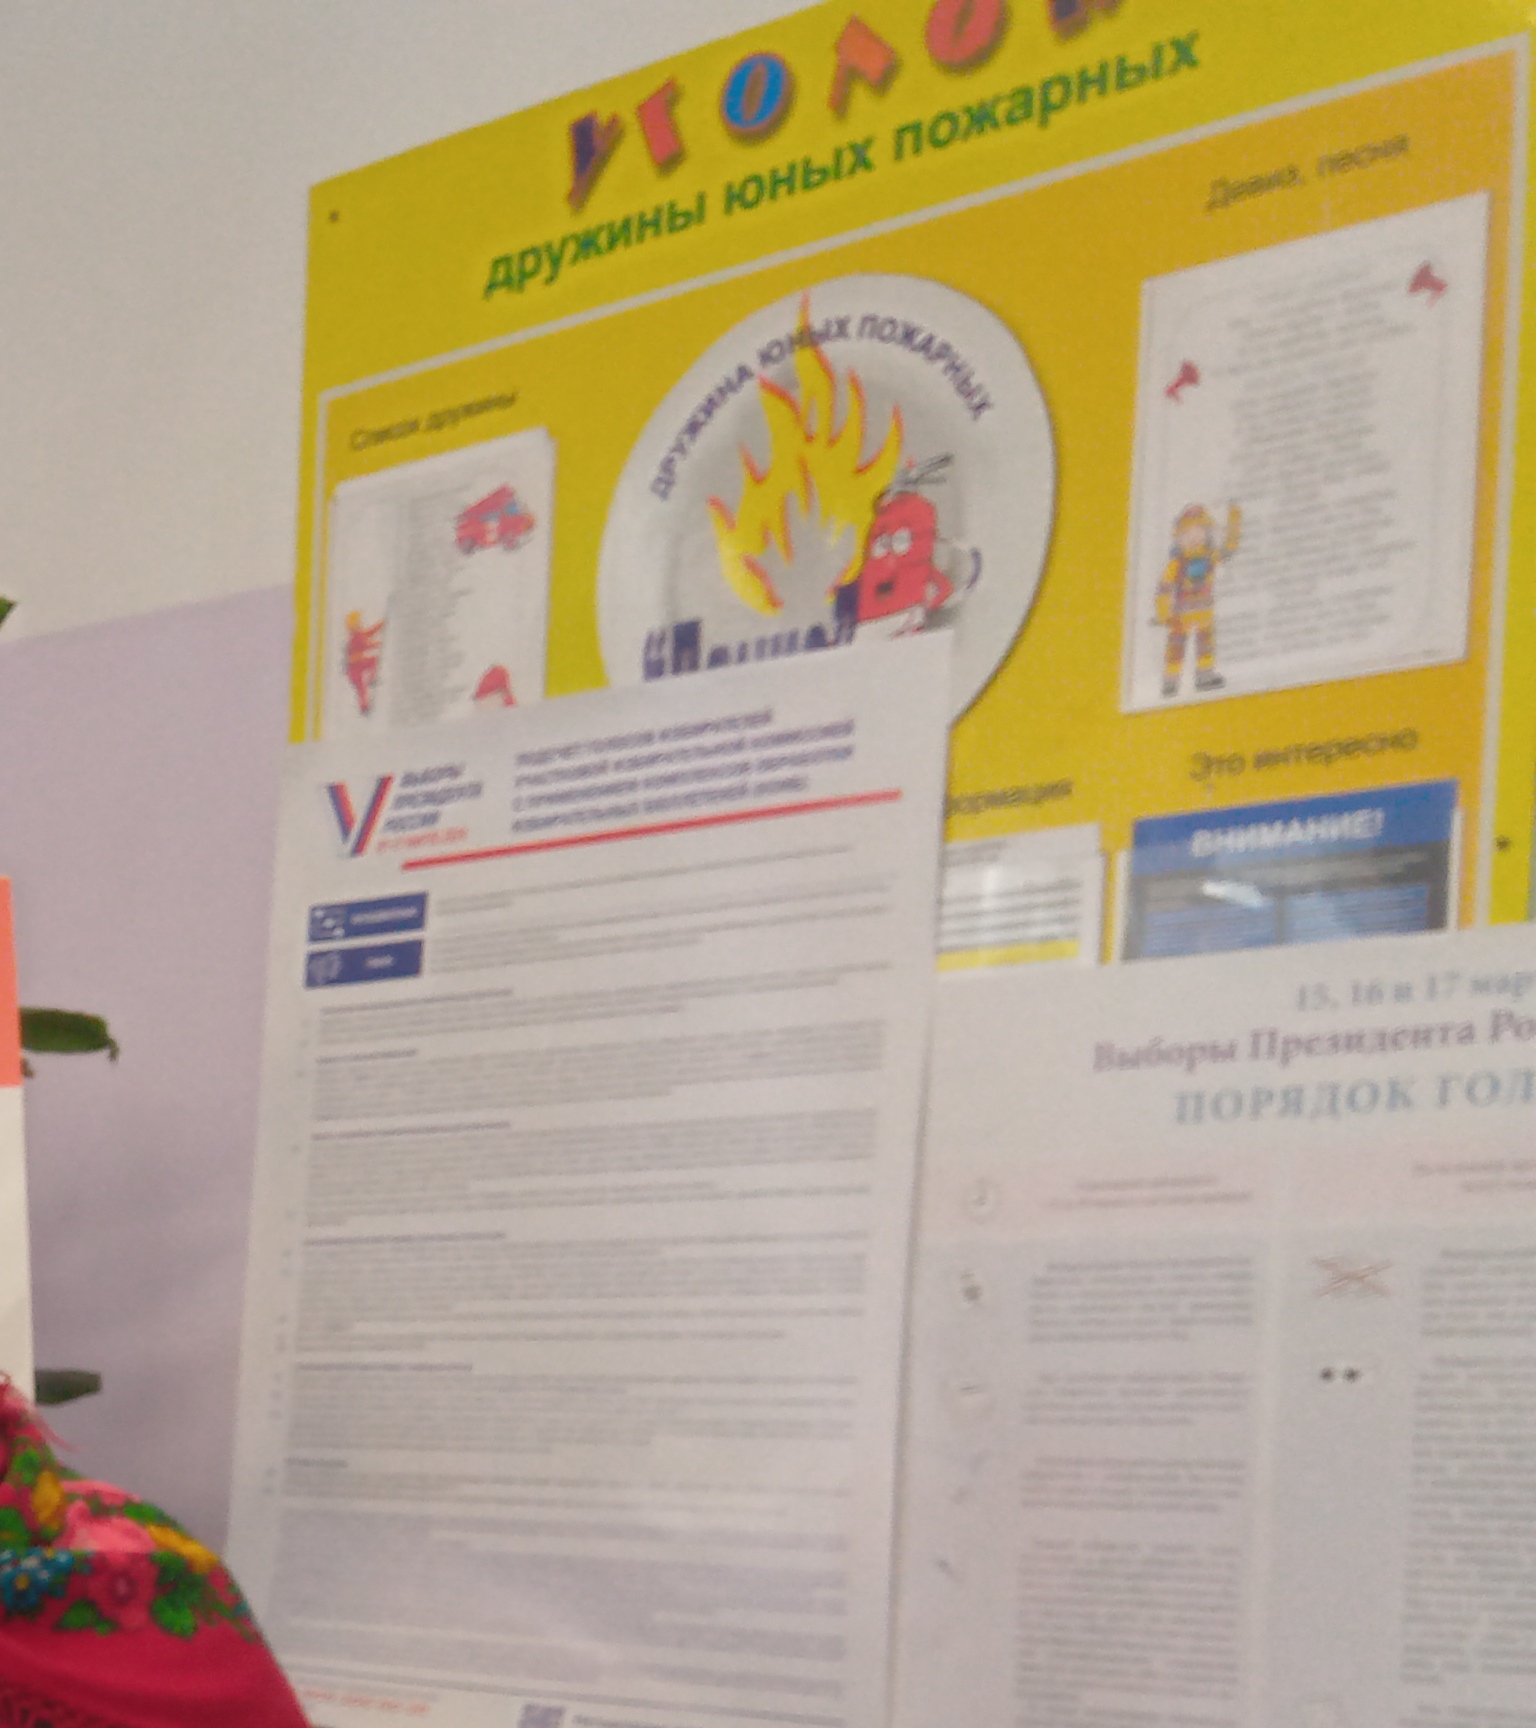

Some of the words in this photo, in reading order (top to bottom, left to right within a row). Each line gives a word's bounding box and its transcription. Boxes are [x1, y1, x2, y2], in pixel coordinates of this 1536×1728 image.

[485, 191, 706, 298] дружины
[725, 138, 875, 217] юных
[893, 31, 1200, 162] пожарных
[651, 366, 754, 499] ДРУЖИНА
[859, 314, 994, 420] ПОЖАРНЫХ
[1190, 751, 1246, 781] Это
[1253, 728, 1419, 770] интересно
[1192, 808, 1385, 857] ВНИМАНИЕ!
[1093, 1035, 1238, 1075] Выборы
[1248, 1019, 1477, 1070] Президента
[1175, 1075, 1416, 1126] ПОРЯДОК
